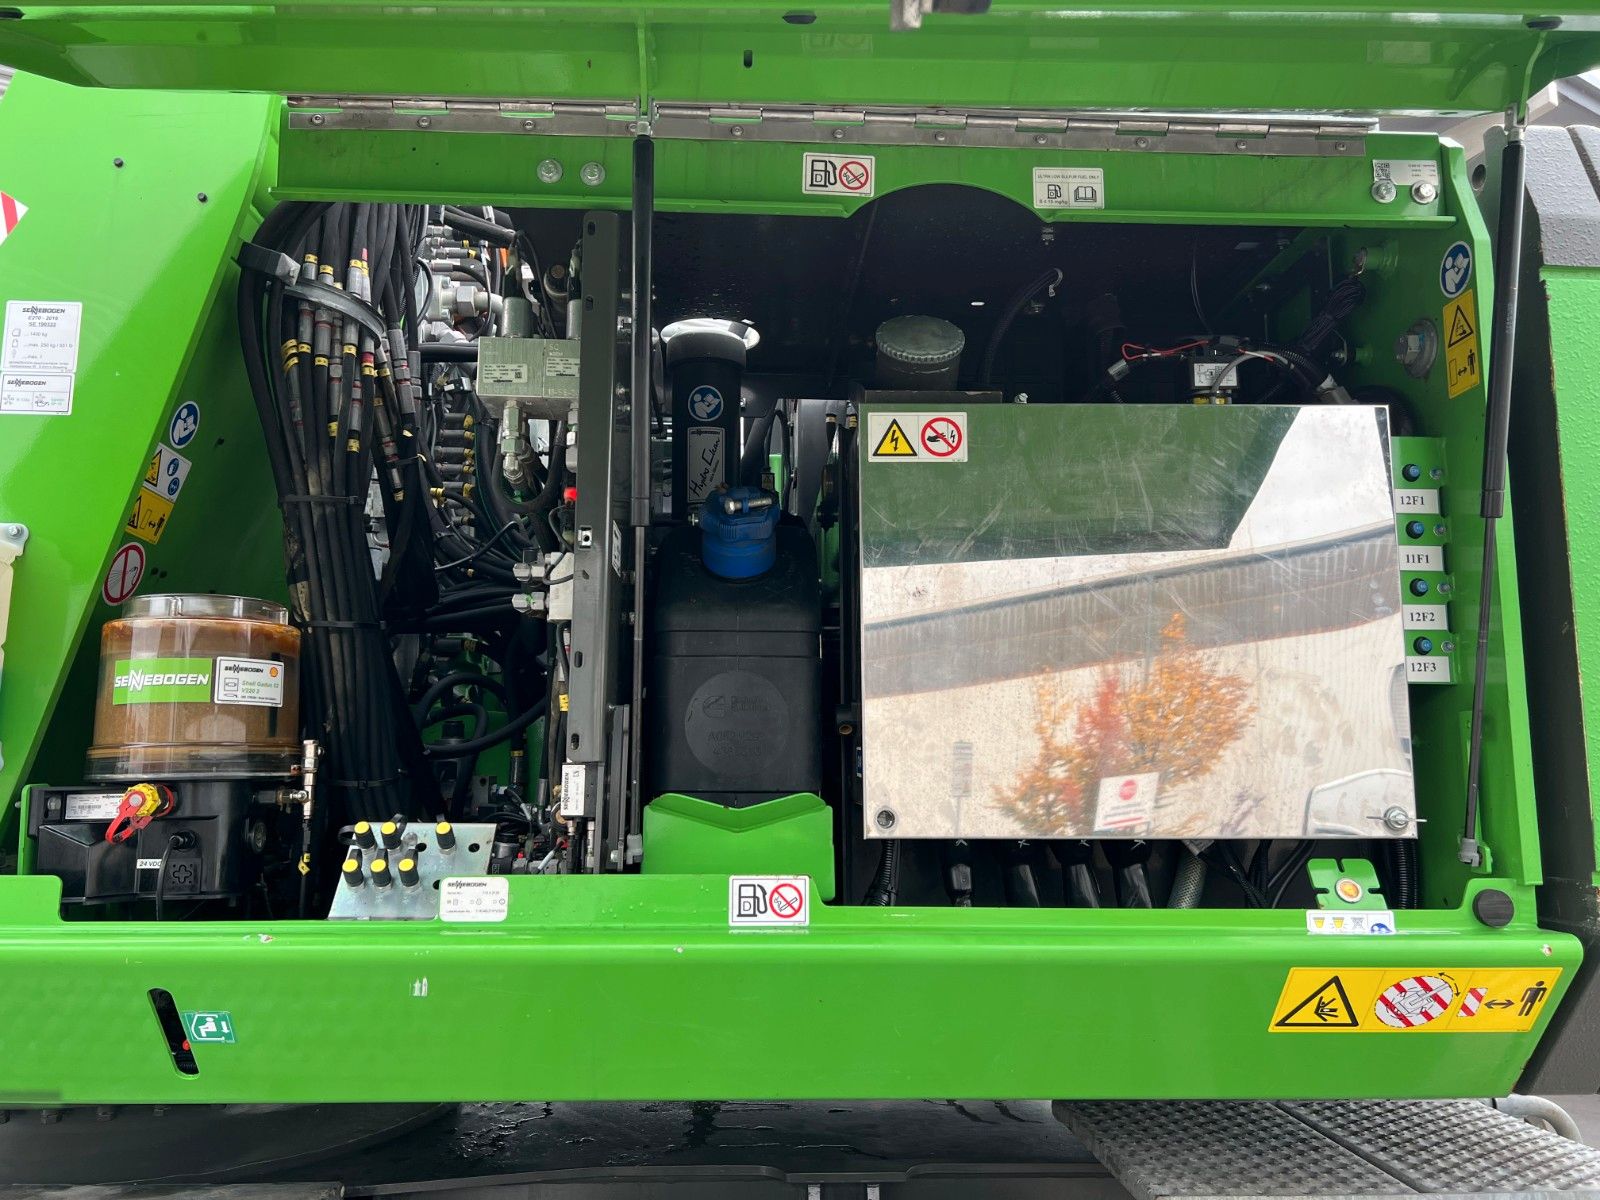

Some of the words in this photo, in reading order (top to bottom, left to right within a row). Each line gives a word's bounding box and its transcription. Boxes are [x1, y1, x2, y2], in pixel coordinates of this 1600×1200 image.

[22, 306, 65, 315] SENNEBOGEN
[7, 378, 47, 387] SENNEBOGEN
[1400, 496, 1425, 505] 12F1
[1406, 554, 1430, 564] 11F1
[1410, 612, 1435, 622] 12F2
[224, 664, 264, 674] SENNEBOGEN
[1411, 662, 1437, 672] 12F3
[115, 669, 209, 692] SENNEBOGEN
[562, 772, 570, 810] SENNEBOGEN
[447, 881, 487, 889] SENNEBOGEN
